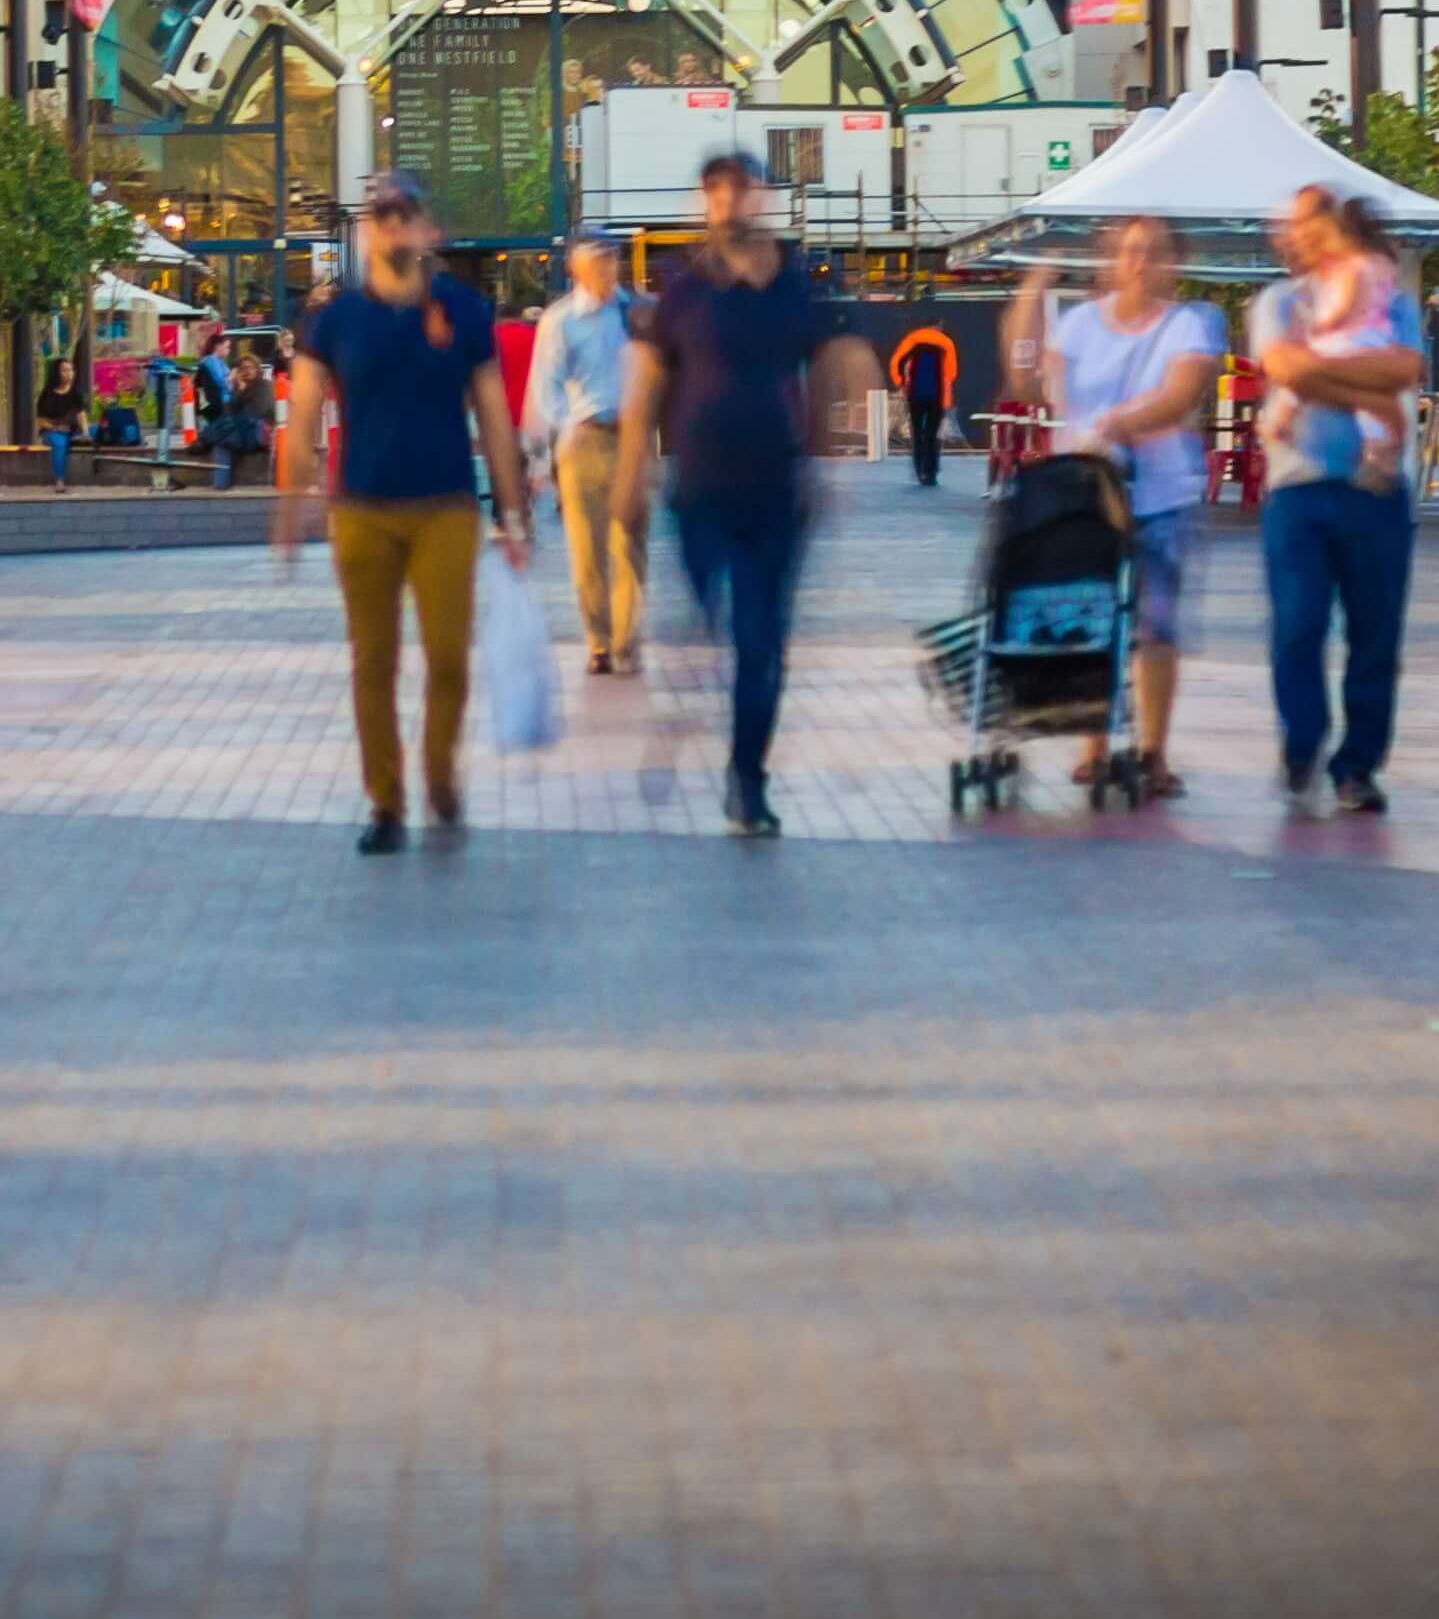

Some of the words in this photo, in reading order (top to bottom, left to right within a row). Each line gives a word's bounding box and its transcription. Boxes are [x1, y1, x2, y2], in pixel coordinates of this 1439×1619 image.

[433, 17, 521, 30] GENERATION
[433, 35, 490, 49] FAMILY
[398, 51, 426, 65] ONE
[434, 50, 518, 65] WESTFIELD
